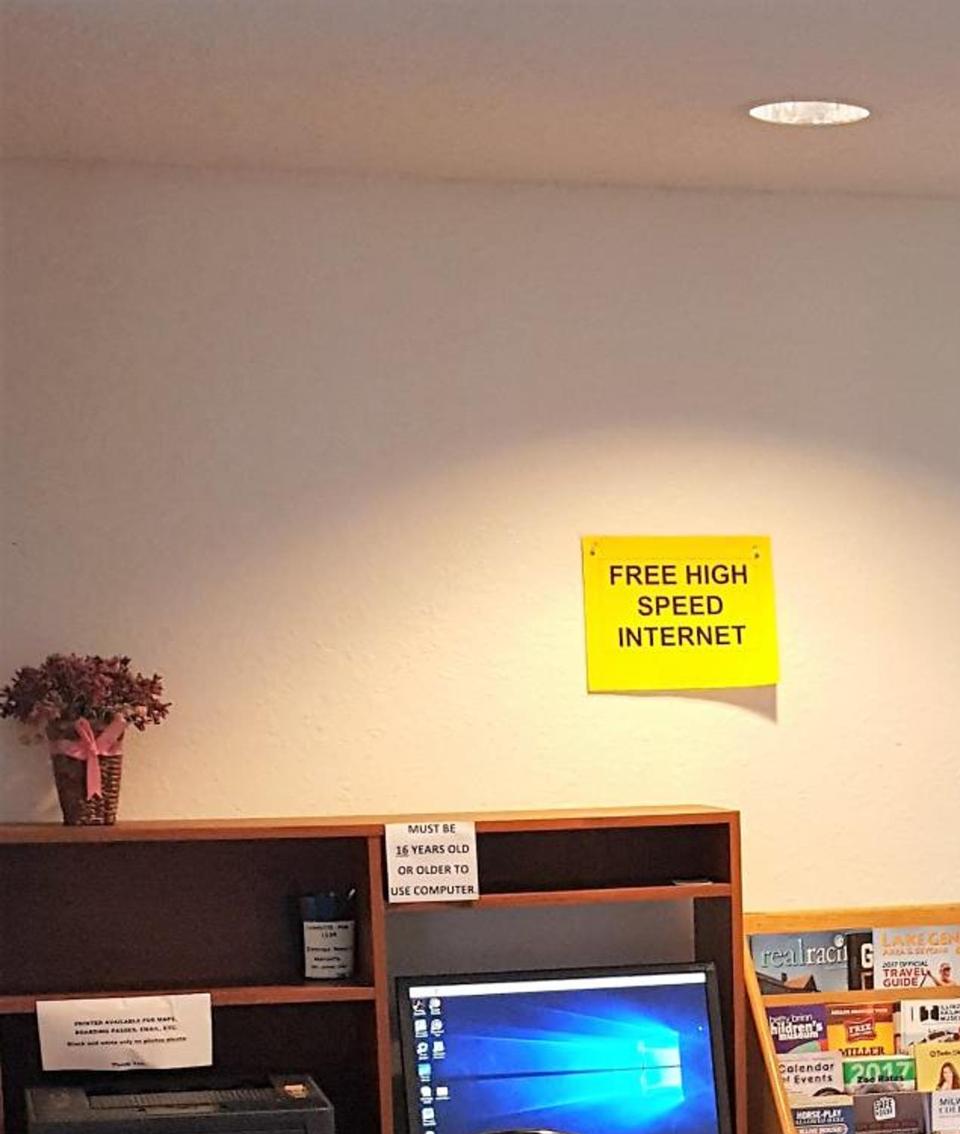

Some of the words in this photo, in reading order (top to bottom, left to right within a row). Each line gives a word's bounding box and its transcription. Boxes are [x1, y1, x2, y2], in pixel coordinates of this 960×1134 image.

[609, 564, 677, 585] FREE
[685, 564, 748, 584] HIGH
[637, 595, 724, 616] SPEED
[618, 625, 747, 647] INTERNET
[408, 823, 440, 834] MUST
[442, 823, 456, 833] BE
[395, 845, 409, 857] 16
[411, 844, 445, 854] YEARS
[447, 844, 470, 854] OLD
[397, 865, 413, 875] OR
[415, 865, 452, 875] OLDER
[453, 864, 470, 874] TO
[390, 886, 411, 896] USE
[413, 885, 475, 896] COMPUTER
[883, 967, 928, 978] TRAVEL
[883, 977, 918, 988] GUIDE
[838, 1047, 885, 1057] MILLER
[779, 1063, 834, 1073] Calendar
[851, 1062, 913, 1078] 2017
[794, 1074, 833, 1084] Events
